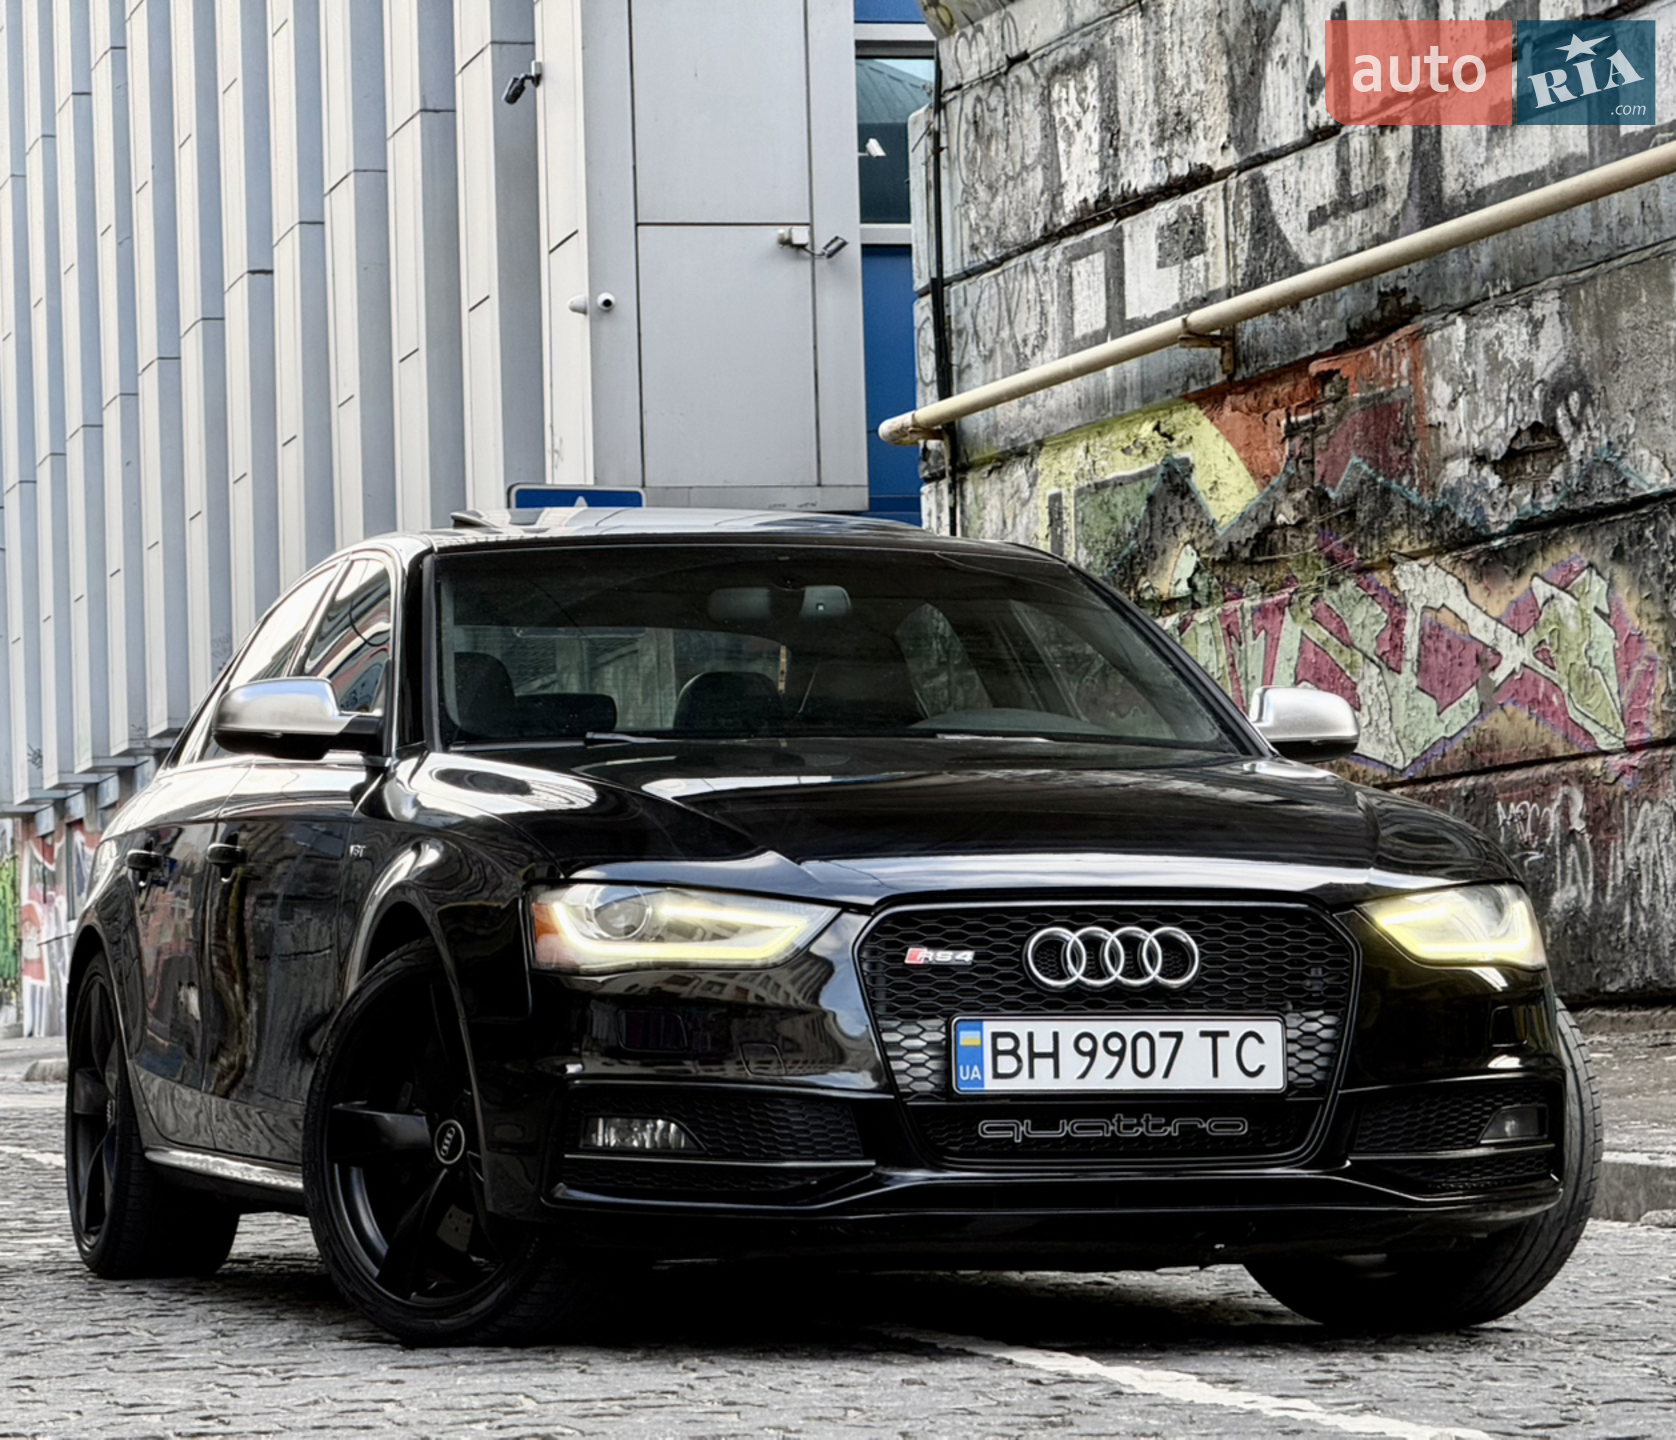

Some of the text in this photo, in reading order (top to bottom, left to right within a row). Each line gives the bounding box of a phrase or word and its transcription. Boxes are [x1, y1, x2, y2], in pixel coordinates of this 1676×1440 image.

[911, 949, 975, 964] RS4
[990, 1030, 1266, 1079] BH 9907 TC
[959, 1065, 982, 1081] UA
[978, 1113, 1248, 1143] quattro
